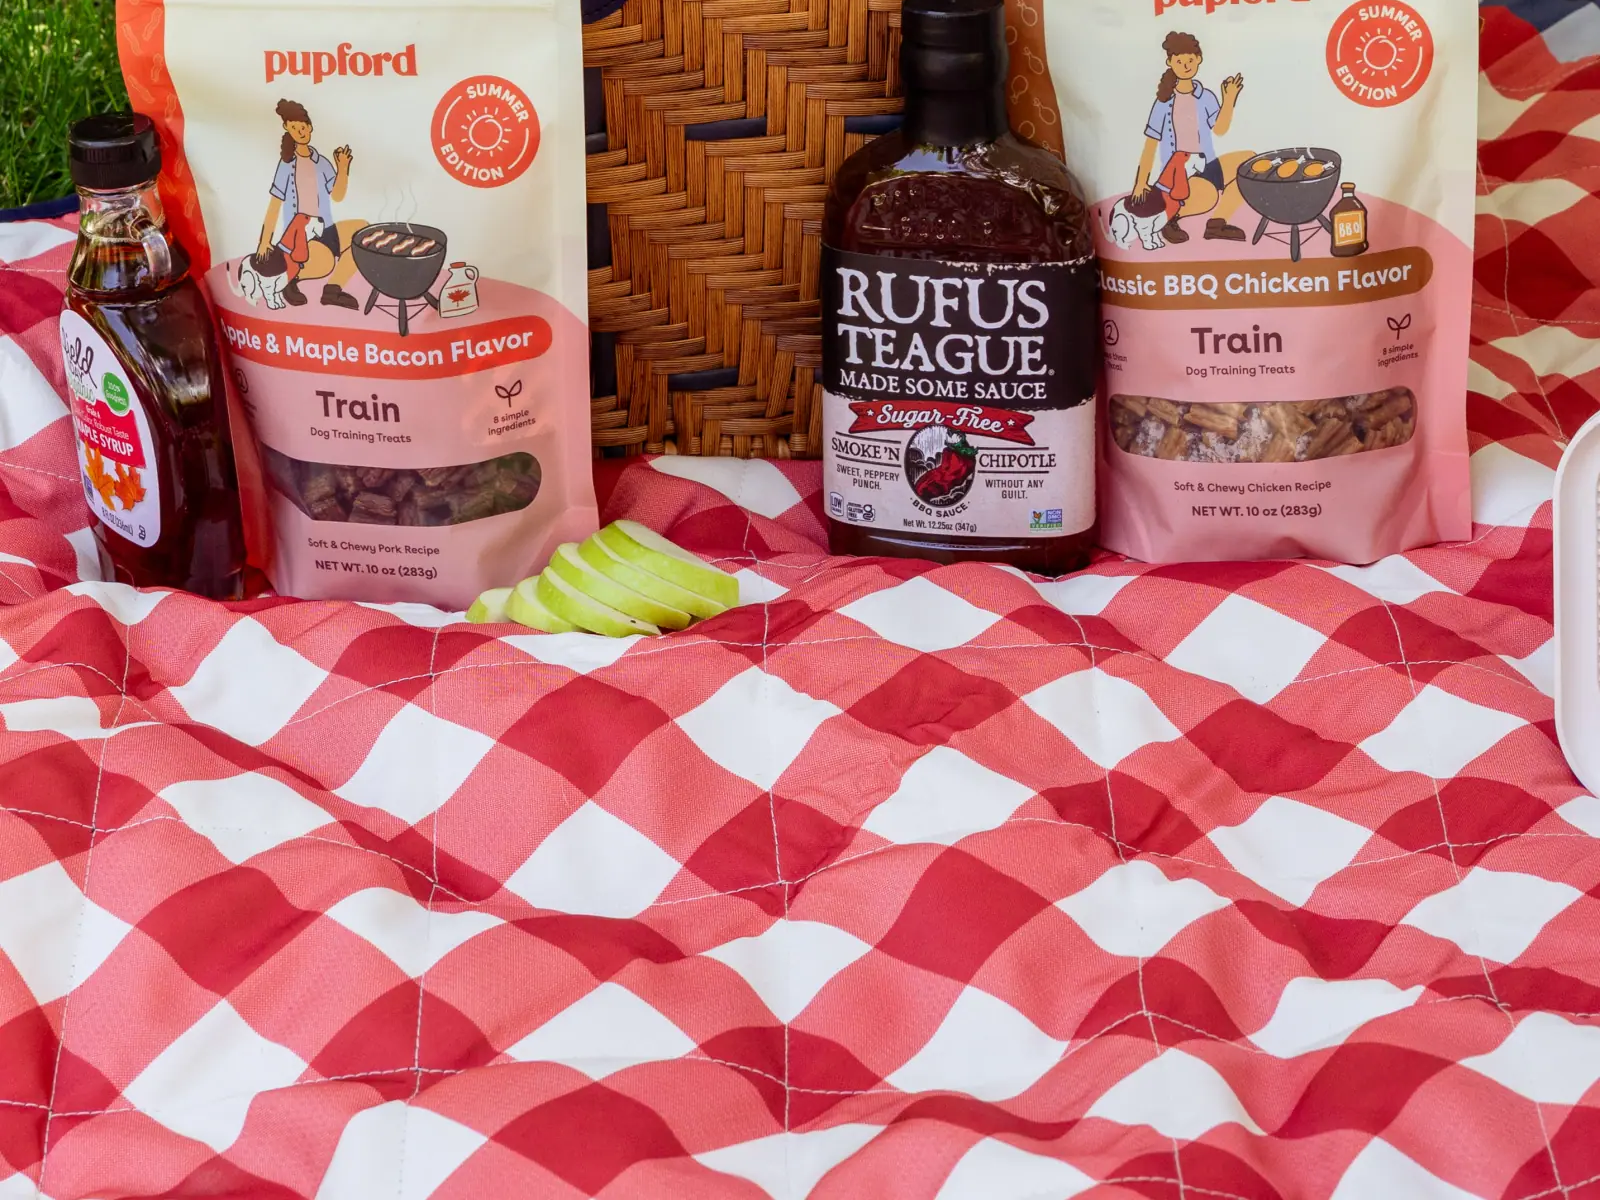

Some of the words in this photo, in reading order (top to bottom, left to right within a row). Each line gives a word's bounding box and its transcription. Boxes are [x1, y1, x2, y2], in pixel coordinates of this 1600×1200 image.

[1358, 5, 1422, 41] SUMMER
[264, 42, 418, 85] pupford
[1336, 65, 1397, 100] EDITION
[466, 83, 529, 124] SUMMER
[440, 143, 504, 182] EDITION
[1164, 273, 1218, 300] BBQ
[1224, 271, 1330, 295] Chicken
[1337, 263, 1412, 292] Flavor
[836, 267, 1049, 329] RUFUS
[265, 332, 280, 355] &
[285, 335, 359, 365] Maple
[365, 343, 444, 366] Bacon
[451, 330, 534, 363] Flavor
[837, 322, 1048, 376] TEAGUE
[1190, 324, 1283, 355] Train
[1388, 344, 1414, 352] simple
[1378, 352, 1418, 368] ingredients
[1186, 366, 1207, 377] Dog
[1210, 365, 1256, 377] Training
[1258, 364, 1296, 375] Treats
[840, 369, 900, 393] MADE
[905, 378, 968, 398] SOME
[974, 382, 1047, 399] SAUCE
[315, 390, 400, 422] Train
[494, 416, 499, 424] 8
[501, 410, 529, 422] simple
[876, 404, 1004, 432] Sugar-Free
[310, 426, 330, 440] Dog
[332, 428, 374, 443] Training
[376, 432, 412, 443] Treats
[488, 418, 536, 436] ingredients
[100, 434, 134, 456] SYRUP
[831, 437, 881, 459] SMOKE
[884, 447, 900, 461] 'N
[979, 454, 1057, 468] CHIPOTLE
[837, 464, 862, 478] SWEET,
[864, 470, 899, 481] PEPPERY
[853, 478, 881, 490] PUNCH.
[985, 479, 1024, 488] WITHOUT
[1027, 480, 1044, 488] ANY
[1174, 481, 1194, 491] Soft
[1197, 483, 1205, 491] &
[1207, 483, 1245, 494] Chewy
[1248, 483, 1292, 492] Chicken
[1295, 480, 1332, 492] Recipe
[831, 496, 843, 509] LOW
[1002, 490, 1028, 499] GUILT.
[912, 499, 932, 516] BBQ
[936, 504, 968, 518] SAUCE
[1192, 506, 1216, 516] NET
[1219, 506, 1243, 517] WT.
[1246, 506, 1259, 516] 10
[1262, 508, 1277, 516] oz
[1281, 503, 1322, 518] (283g)
[903, 518, 915, 528] Net
[916, 519, 927, 529] Wt.
[928, 520, 953, 530] 12.25oz
[955, 521, 977, 532] (347g)
[308, 538, 328, 549] Soft
[330, 541, 338, 549] &
[340, 541, 376, 554] Chewy
[379, 544, 402, 554] Pork
[405, 546, 439, 556] Recipe
[315, 560, 338, 571] NET
[341, 562, 364, 573] WT.
[366, 565, 378, 574] 10
[382, 567, 396, 576] oz
[398, 565, 437, 580] (283g)
